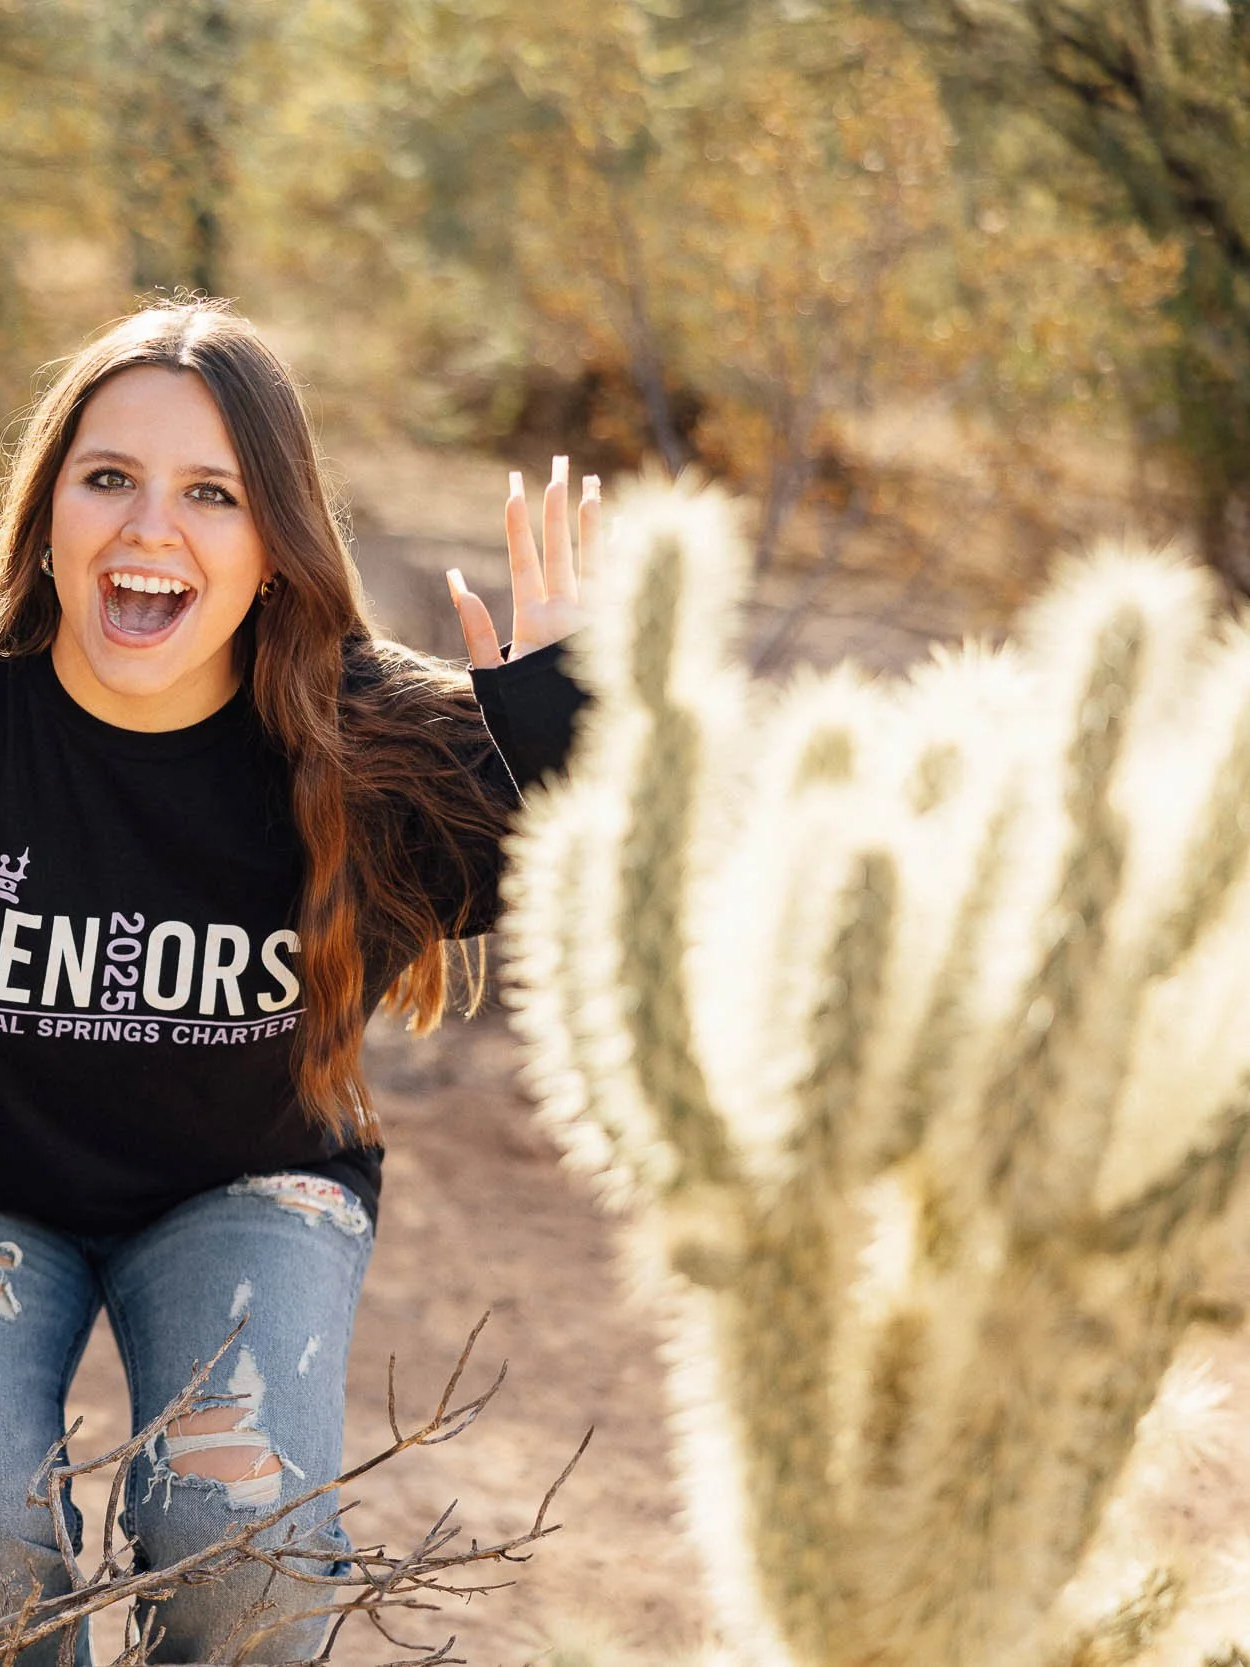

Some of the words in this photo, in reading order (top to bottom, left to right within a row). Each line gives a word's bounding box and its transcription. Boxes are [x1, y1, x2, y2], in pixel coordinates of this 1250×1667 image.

[100, 912, 145, 1012] 2025
[37, 1017, 160, 1043] SPRINGS
[172, 1016, 296, 1045] CHARTER
